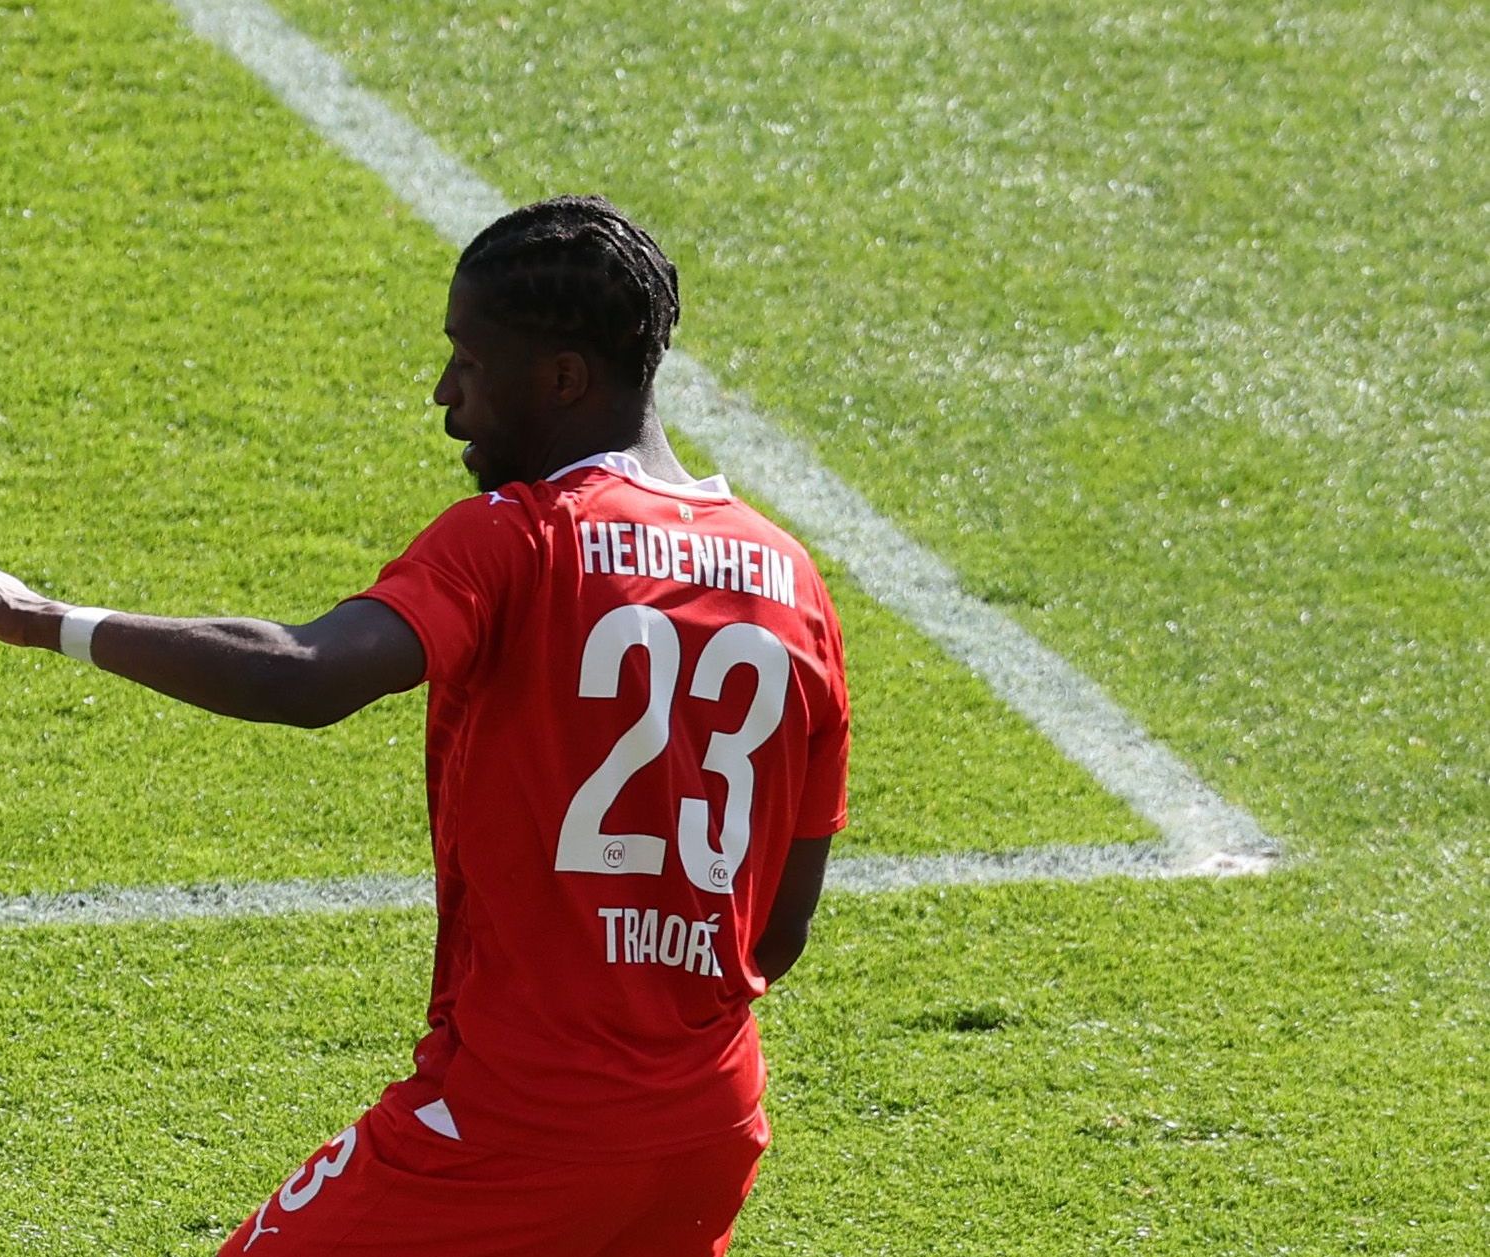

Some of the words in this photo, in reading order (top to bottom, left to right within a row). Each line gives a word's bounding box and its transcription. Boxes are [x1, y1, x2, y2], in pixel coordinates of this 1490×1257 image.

[579, 520, 796, 609] HEIDENHEIM
[554, 603, 790, 895] 23
[597, 912, 724, 978] TRAORÉ
[278, 1125, 357, 1213] 3
